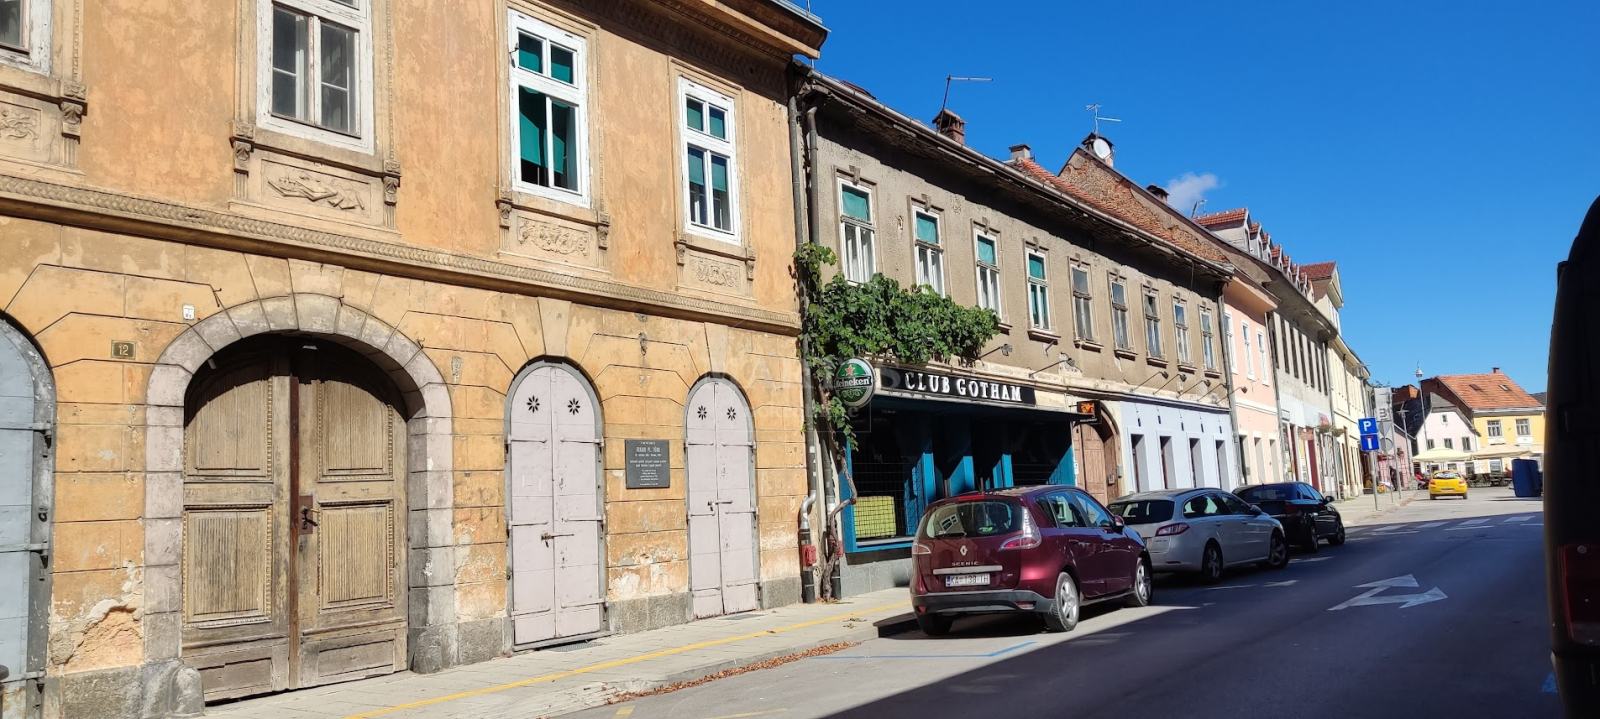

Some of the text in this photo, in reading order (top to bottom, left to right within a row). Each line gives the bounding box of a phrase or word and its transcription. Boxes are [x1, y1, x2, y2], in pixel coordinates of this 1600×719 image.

[119, 344, 129, 356] 12
[904, 372, 1023, 402] CLUB GOTHAM
[1363, 421, 1372, 432] P
